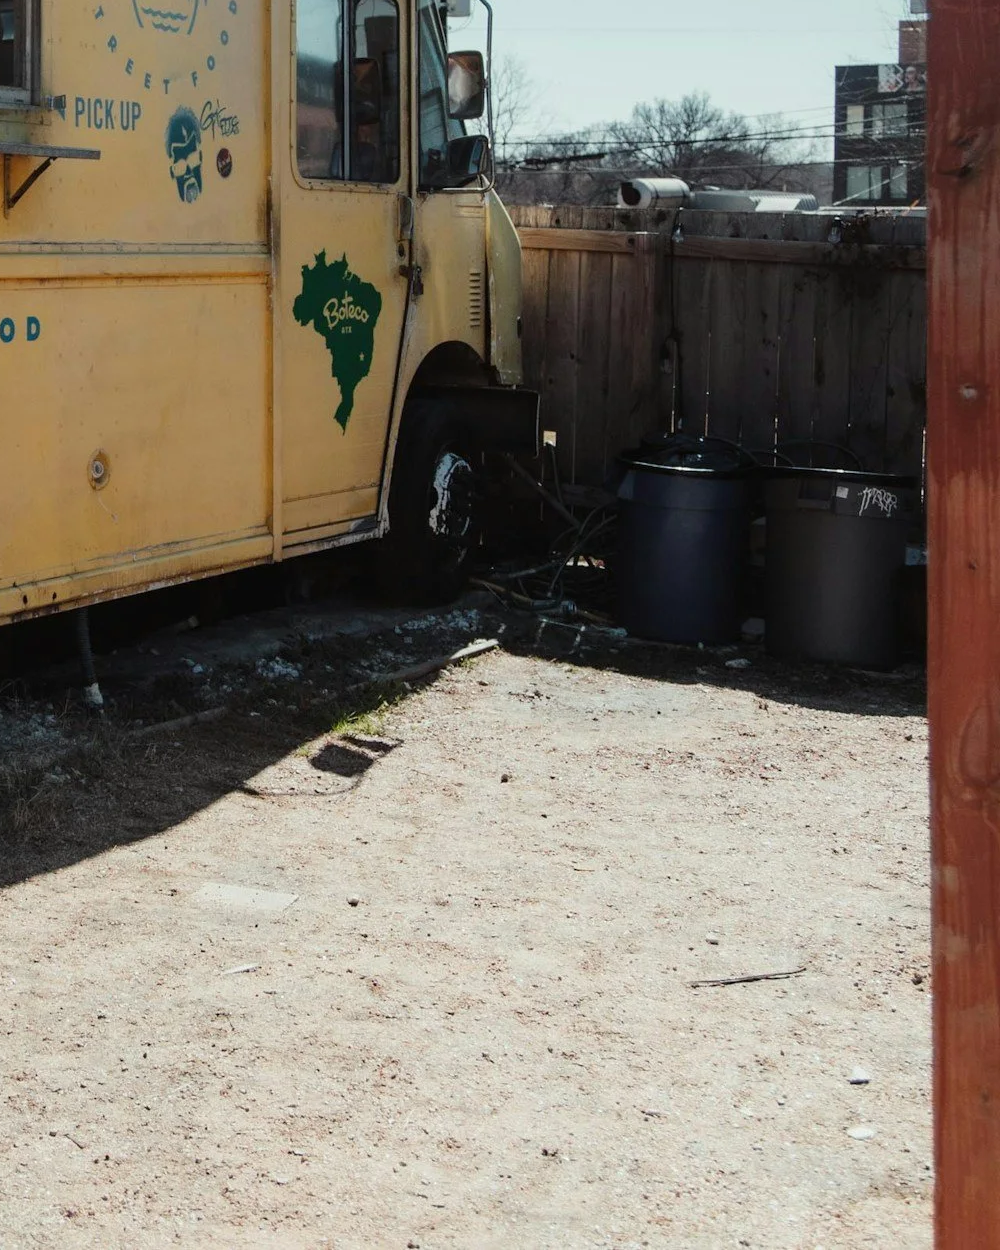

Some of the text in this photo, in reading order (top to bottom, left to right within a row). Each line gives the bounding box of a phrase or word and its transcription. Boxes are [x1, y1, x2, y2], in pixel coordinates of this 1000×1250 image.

[191, 0, 238, 88] FOOD
[75, 96, 142, 131] PICK UP
[322, 290, 370, 330] Boteco
